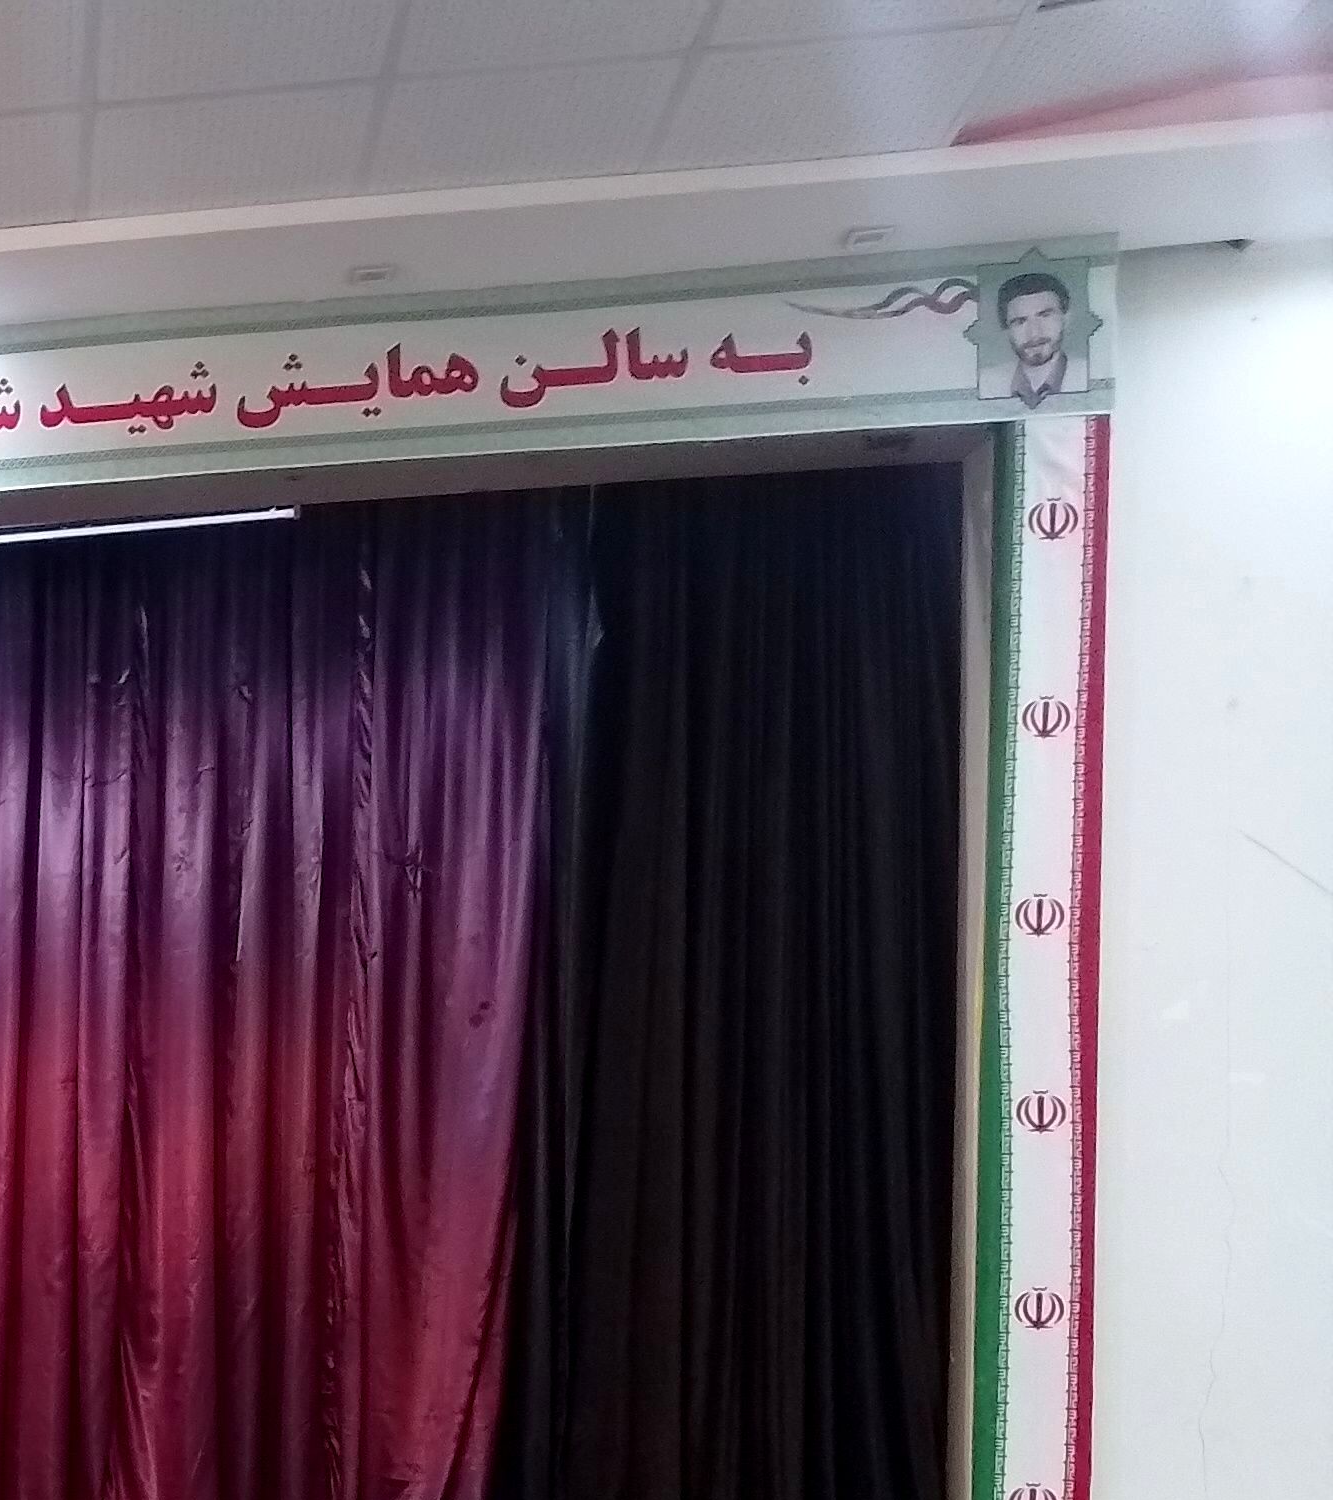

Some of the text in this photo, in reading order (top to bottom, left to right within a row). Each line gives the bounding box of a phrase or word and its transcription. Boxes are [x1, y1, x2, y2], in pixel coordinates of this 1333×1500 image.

[236, 343, 479, 429] همایش
[499, 327, 689, 408] سالن
[709, 331, 813, 385] به
[39, 361, 217, 435] شهید
